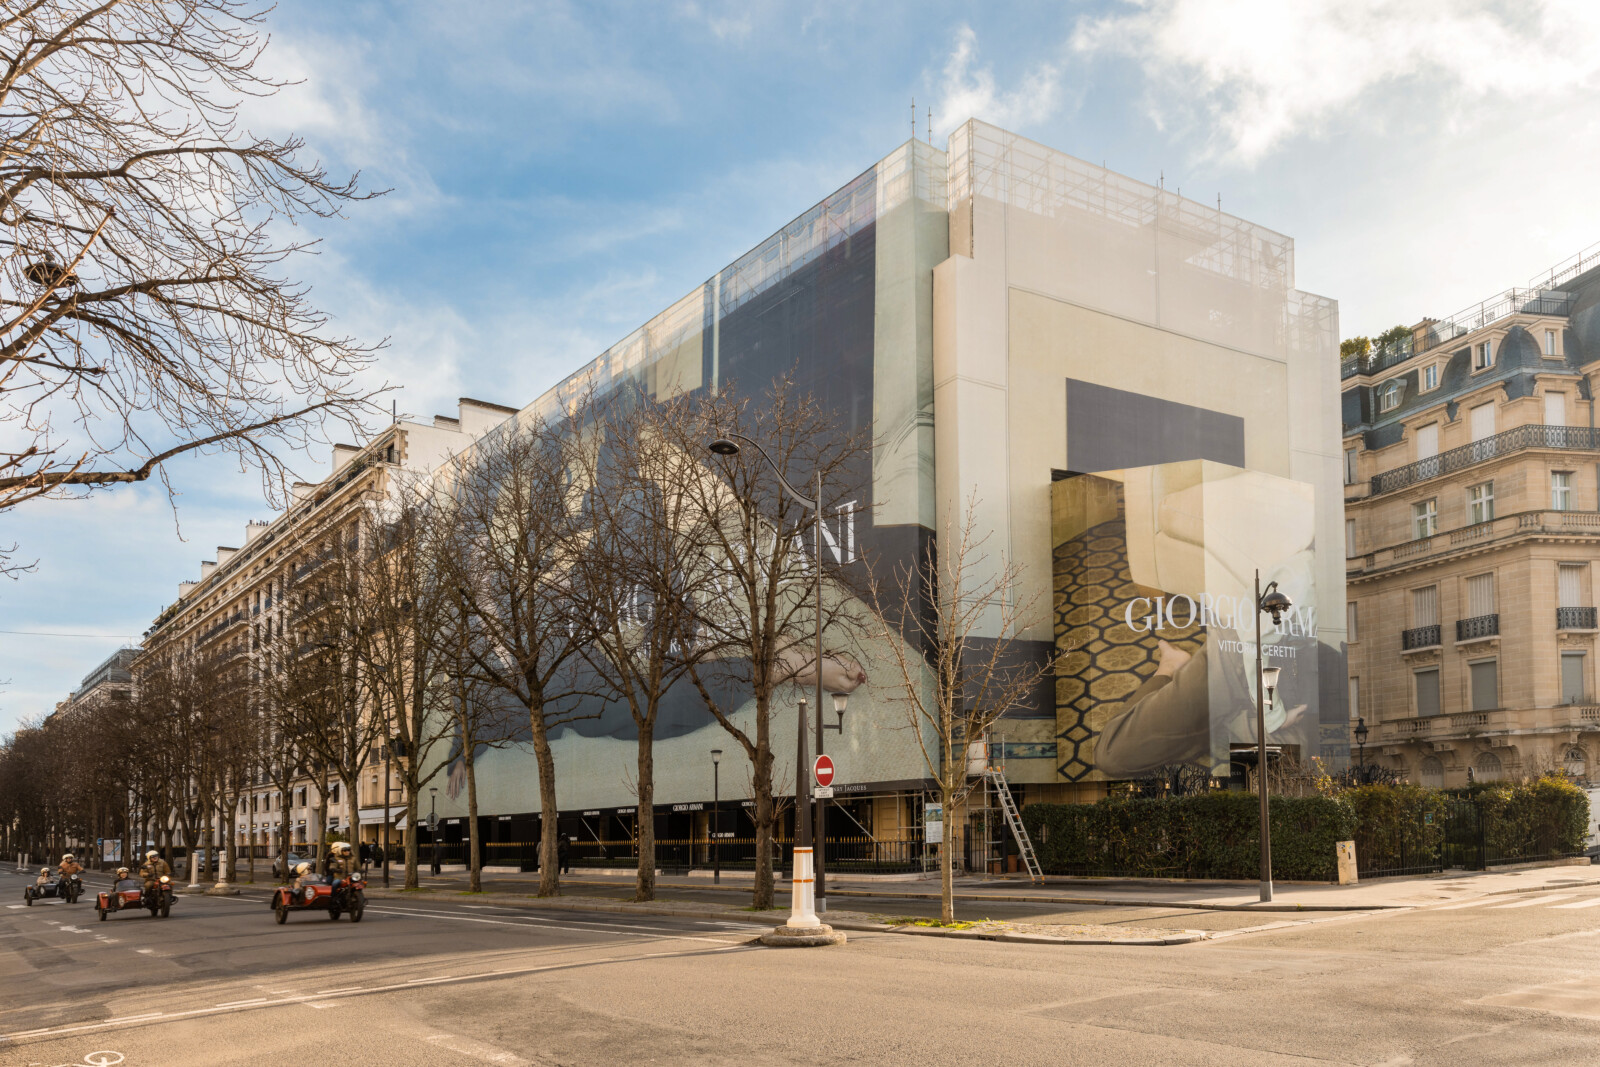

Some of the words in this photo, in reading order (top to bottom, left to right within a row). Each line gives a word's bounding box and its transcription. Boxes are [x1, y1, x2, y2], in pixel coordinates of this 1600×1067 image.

[1124, 592, 1256, 632] GIORGIO
[1261, 644, 1296, 658] CERETTI
[844, 784, 867, 792] JACQUES
